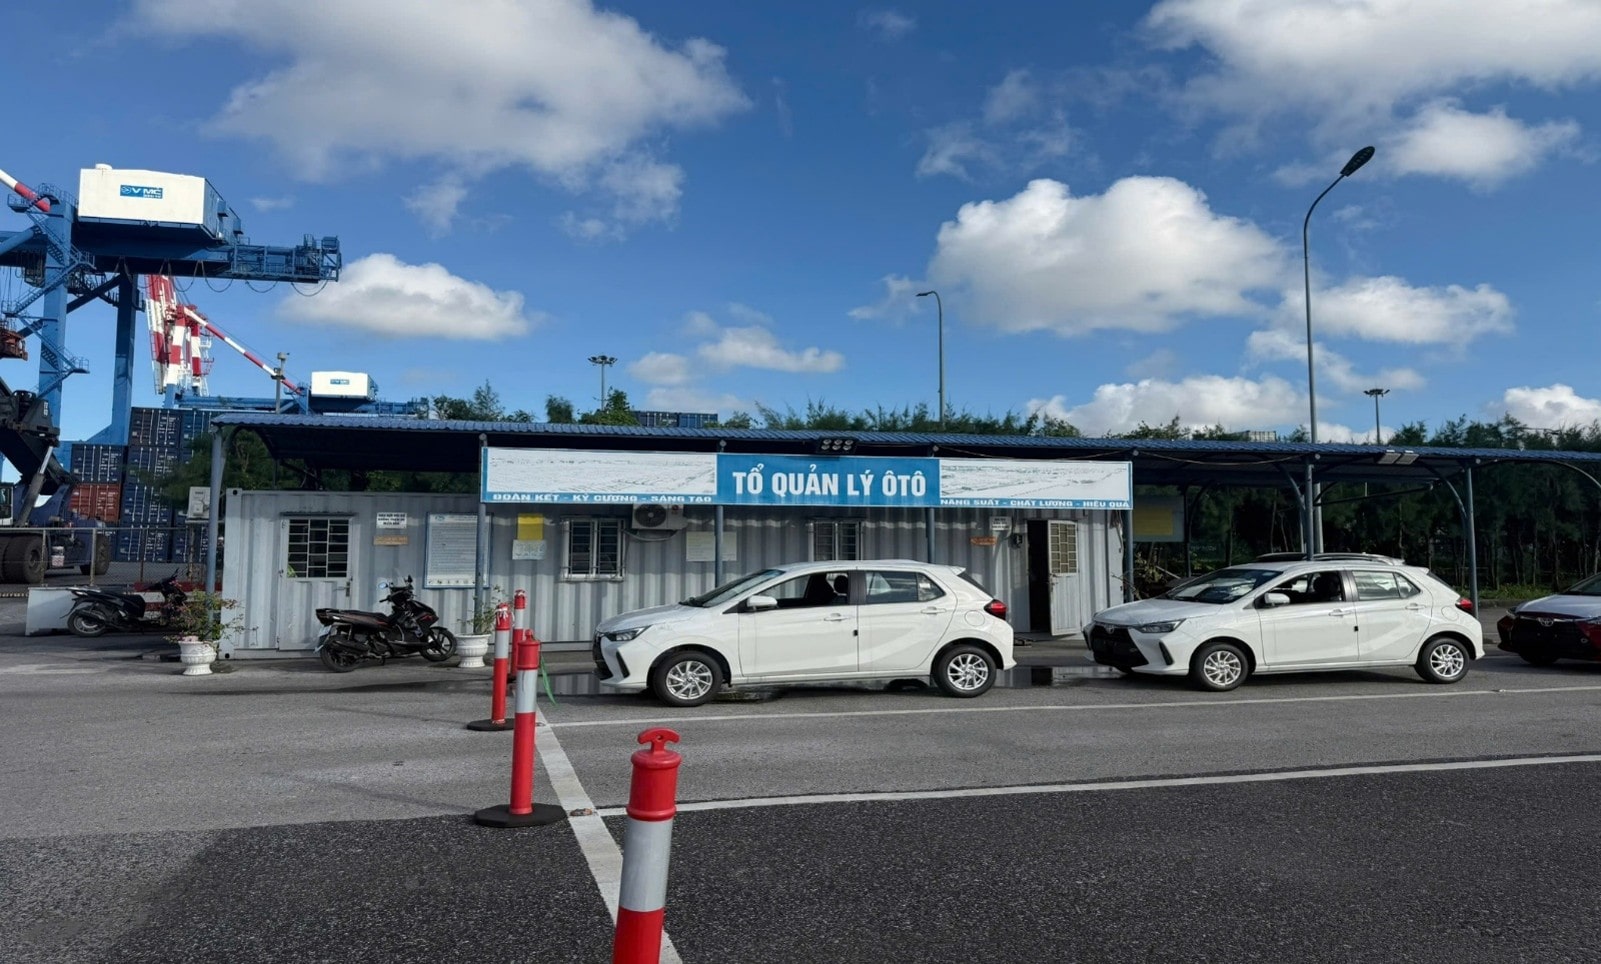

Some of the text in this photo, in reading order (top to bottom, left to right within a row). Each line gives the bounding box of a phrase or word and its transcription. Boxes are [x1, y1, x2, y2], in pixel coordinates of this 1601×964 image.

[732, 463, 926, 497] TỔ QUẢN LÝ ÔTÔ
[650, 494, 685, 503] SÁNG
